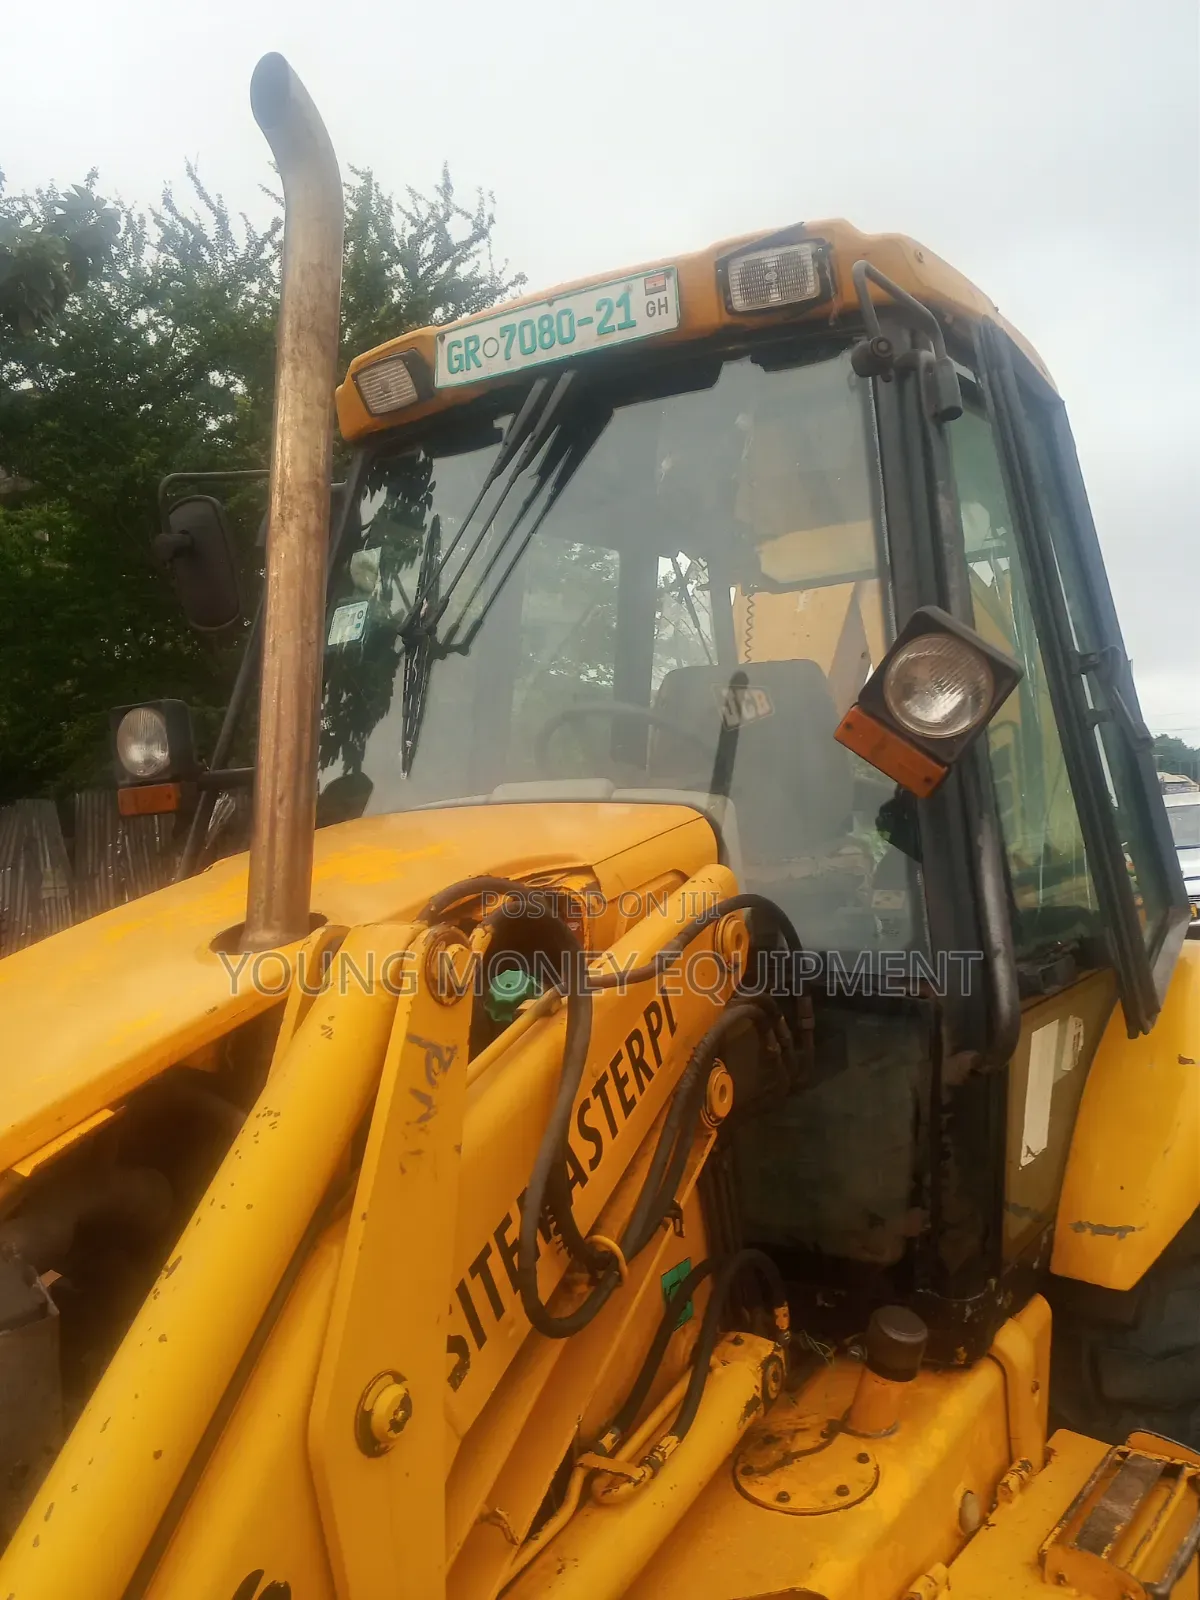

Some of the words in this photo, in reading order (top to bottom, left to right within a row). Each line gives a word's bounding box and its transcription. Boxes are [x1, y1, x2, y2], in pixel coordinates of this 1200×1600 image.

[446, 335, 482, 374] GR
[499, 291, 637, 361] 7080-21
[645, 296, 669, 318] GH
